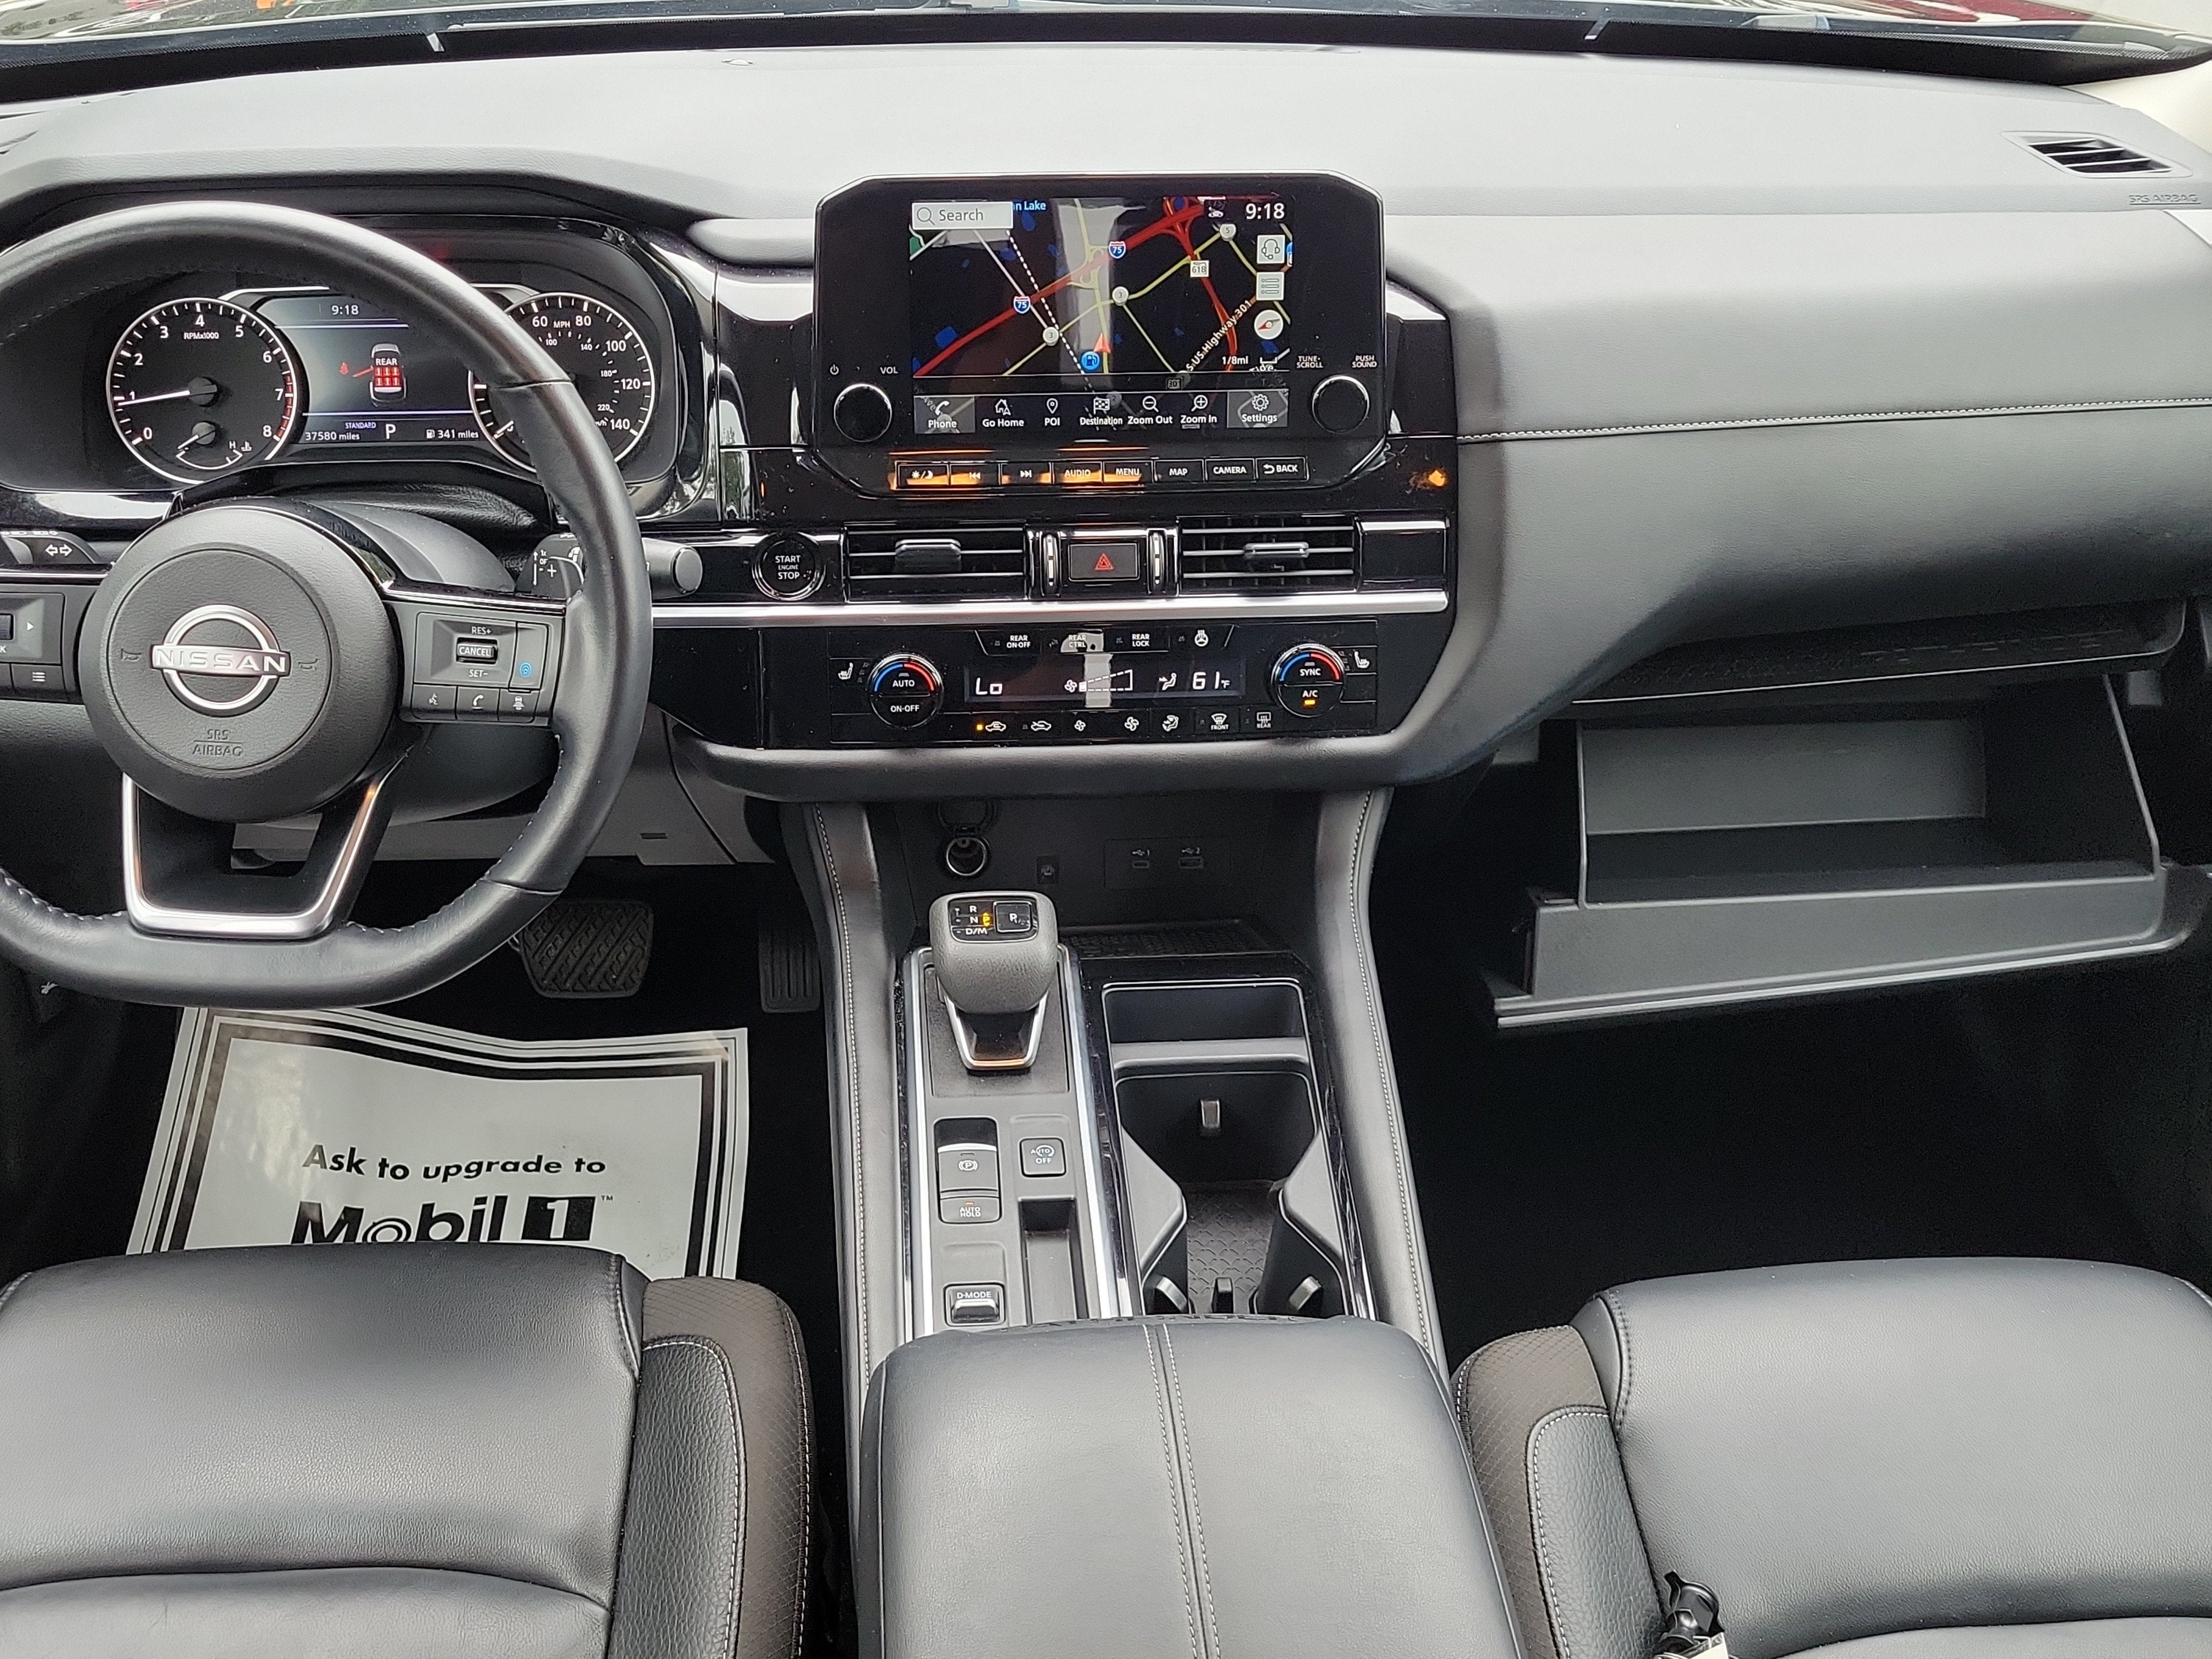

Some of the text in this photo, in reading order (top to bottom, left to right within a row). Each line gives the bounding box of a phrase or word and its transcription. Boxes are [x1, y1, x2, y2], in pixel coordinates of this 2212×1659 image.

[2129, 194, 2198, 203] SRS AIRBAG
[1024, 200, 1046, 211] Lake
[1245, 202, 1285, 219] 9:18
[939, 208, 984, 221] Search
[331, 304, 359, 315] 9:18
[1017, 301, 1026, 309] 75
[195, 314, 205, 327] 4
[532, 315, 548, 328] 60
[553, 320, 571, 329] MPH
[575, 315, 591, 327] 80
[160, 325, 168, 338] 3
[184, 331, 219, 340] RPMx1000
[235, 325, 244, 337] 5
[1191, 351, 1205, 365] US
[1205, 315, 1238, 354] Highway
[1234, 300, 1252, 318] 301
[605, 340, 627, 352] 100
[134, 353, 143, 366] 2
[263, 351, 272, 363] 6
[375, 358, 398, 366] REAR
[1222, 356, 1249, 365] 1/8mi
[620, 378, 641, 390] 120
[129, 391, 136, 400] 1
[275, 388, 284, 401] 7
[928, 419, 957, 428] Phone
[982, 418, 1024, 427] Go Home
[1044, 417, 1060, 426] POI
[1079, 416, 1123, 426] Destination
[1127, 415, 1173, 425] Zoom Out
[1180, 414, 1218, 424] Zoom In
[1241, 413, 1278, 424] Settings
[610, 419, 630, 430] 140
[143, 427, 153, 439] 0
[263, 425, 272, 437] 8
[386, 424, 396, 439] P
[437, 430, 479, 439] 341 miles
[305, 432, 360, 441] 37580 miles
[229, 441, 236, 449] H
[1064, 469, 1091, 477] AUDIO
[1115, 467, 1140, 477] MENU
[1169, 467, 1188, 476] MAP
[1213, 466, 1247, 475] CAMERA
[1276, 464, 1299, 473] BACK
[775, 555, 801, 563] START
[778, 572, 800, 580] STOP
[471, 626, 492, 635] RES+
[459, 646, 491, 657] CANCEL
[155, 649, 286, 673] NISSAN
[1300, 668, 1322, 676] SYNC
[892, 679, 915, 687] AUTO
[1302, 690, 1318, 698] A/C
[890, 704, 920, 713] ON-OFF
[207, 729, 231, 741] SRS
[192, 743, 244, 757] AIRBAG
[969, 905, 977, 913] R
[965, 927, 988, 935] D/M
[302, 1144, 606, 1183] Ask to upgrade to
[291, 1194, 509, 1245] Mobil
[956, 1291, 992, 1299] D-MODE
